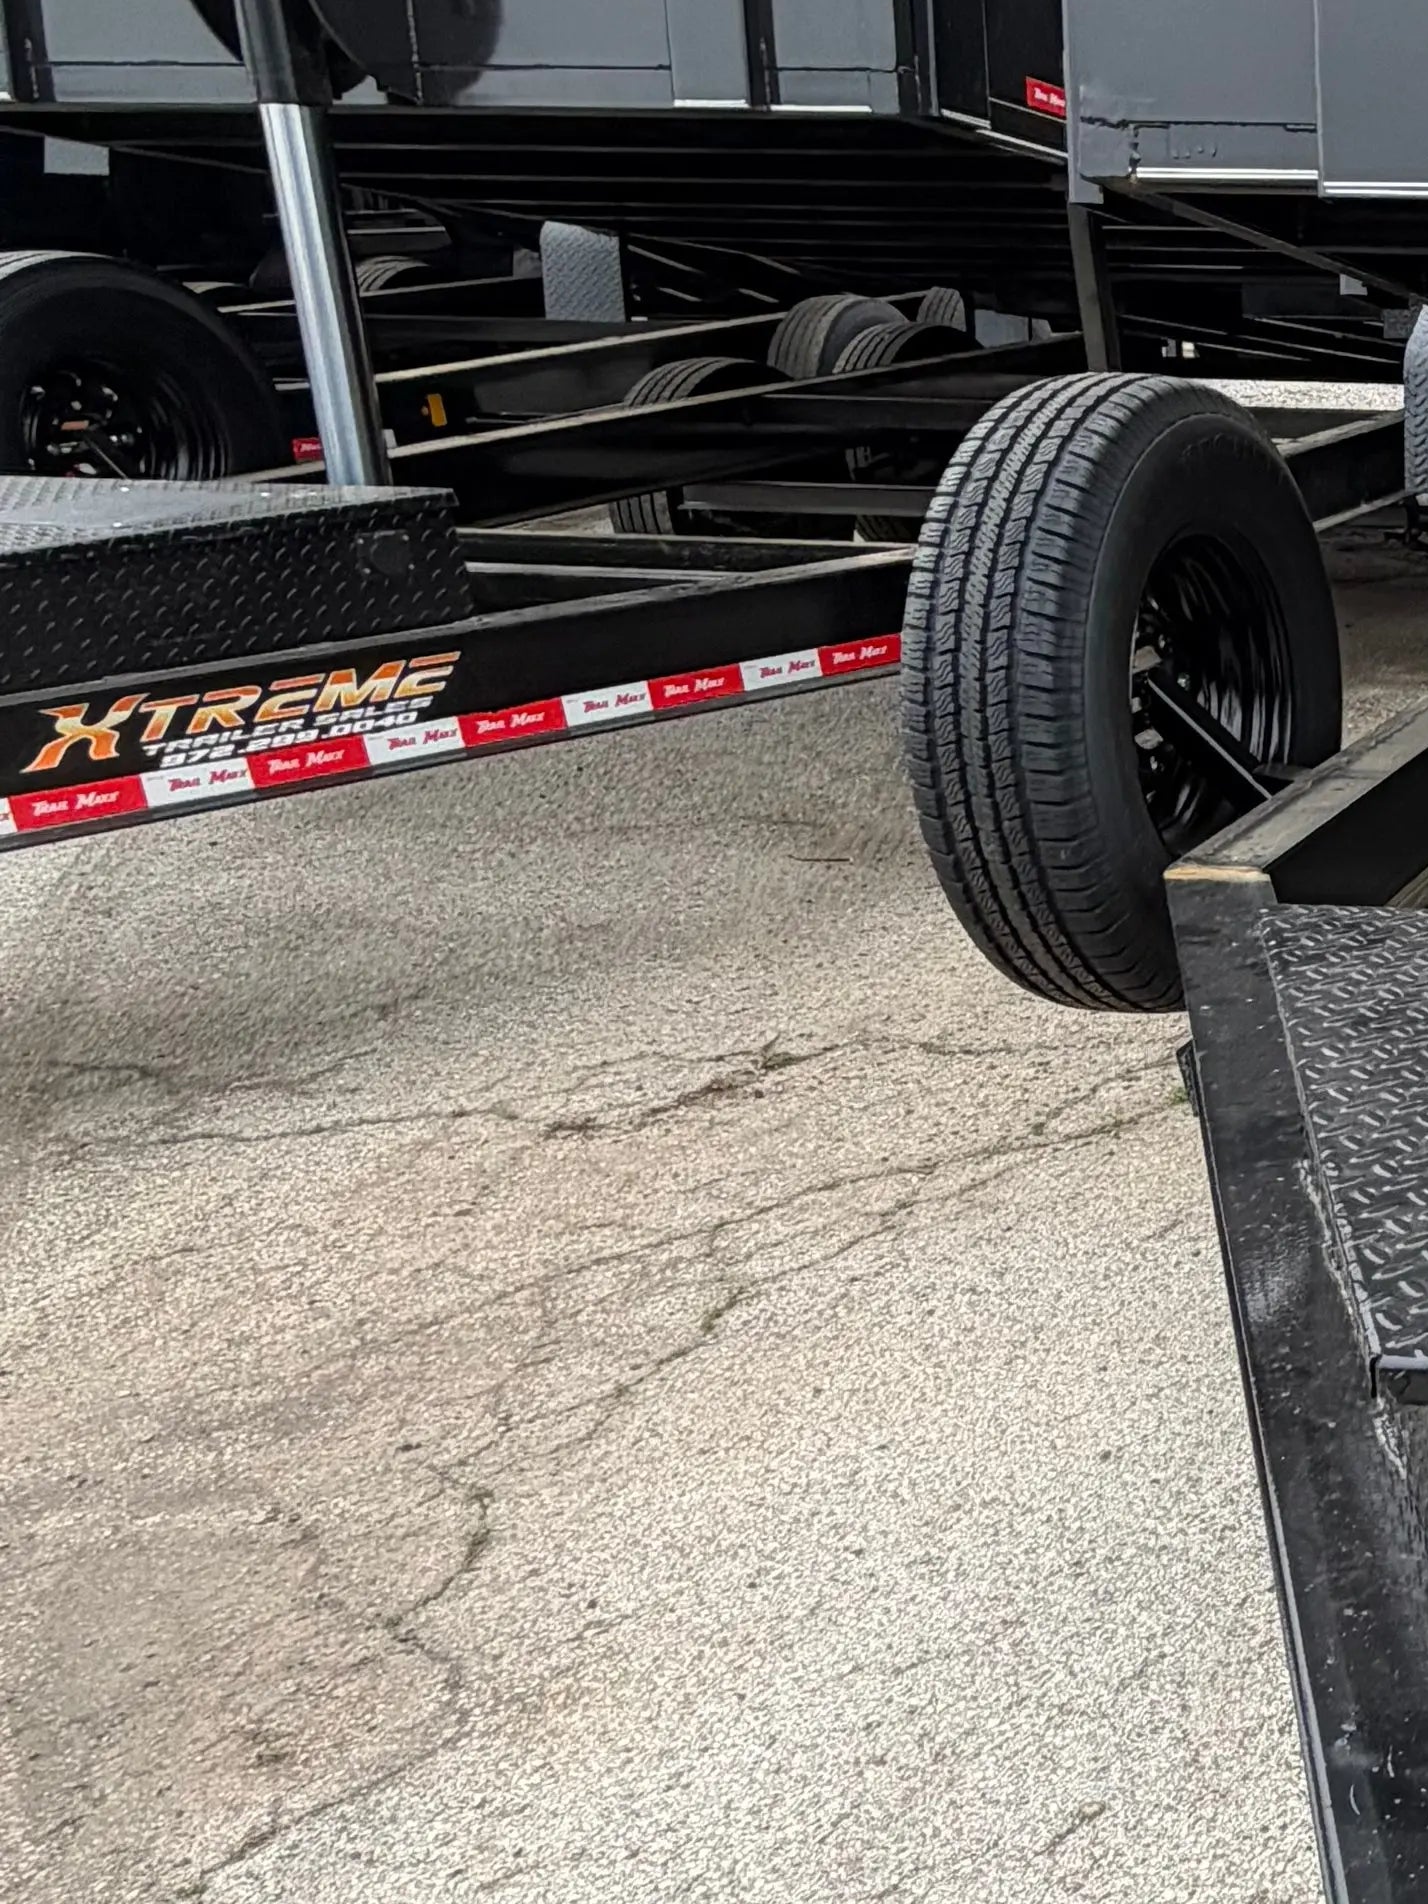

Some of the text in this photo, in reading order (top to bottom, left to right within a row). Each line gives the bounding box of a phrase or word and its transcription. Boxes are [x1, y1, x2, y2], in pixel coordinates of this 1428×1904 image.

[19, 650, 462, 774] XTREME
[142, 695, 435, 757] TRAILER SALES
